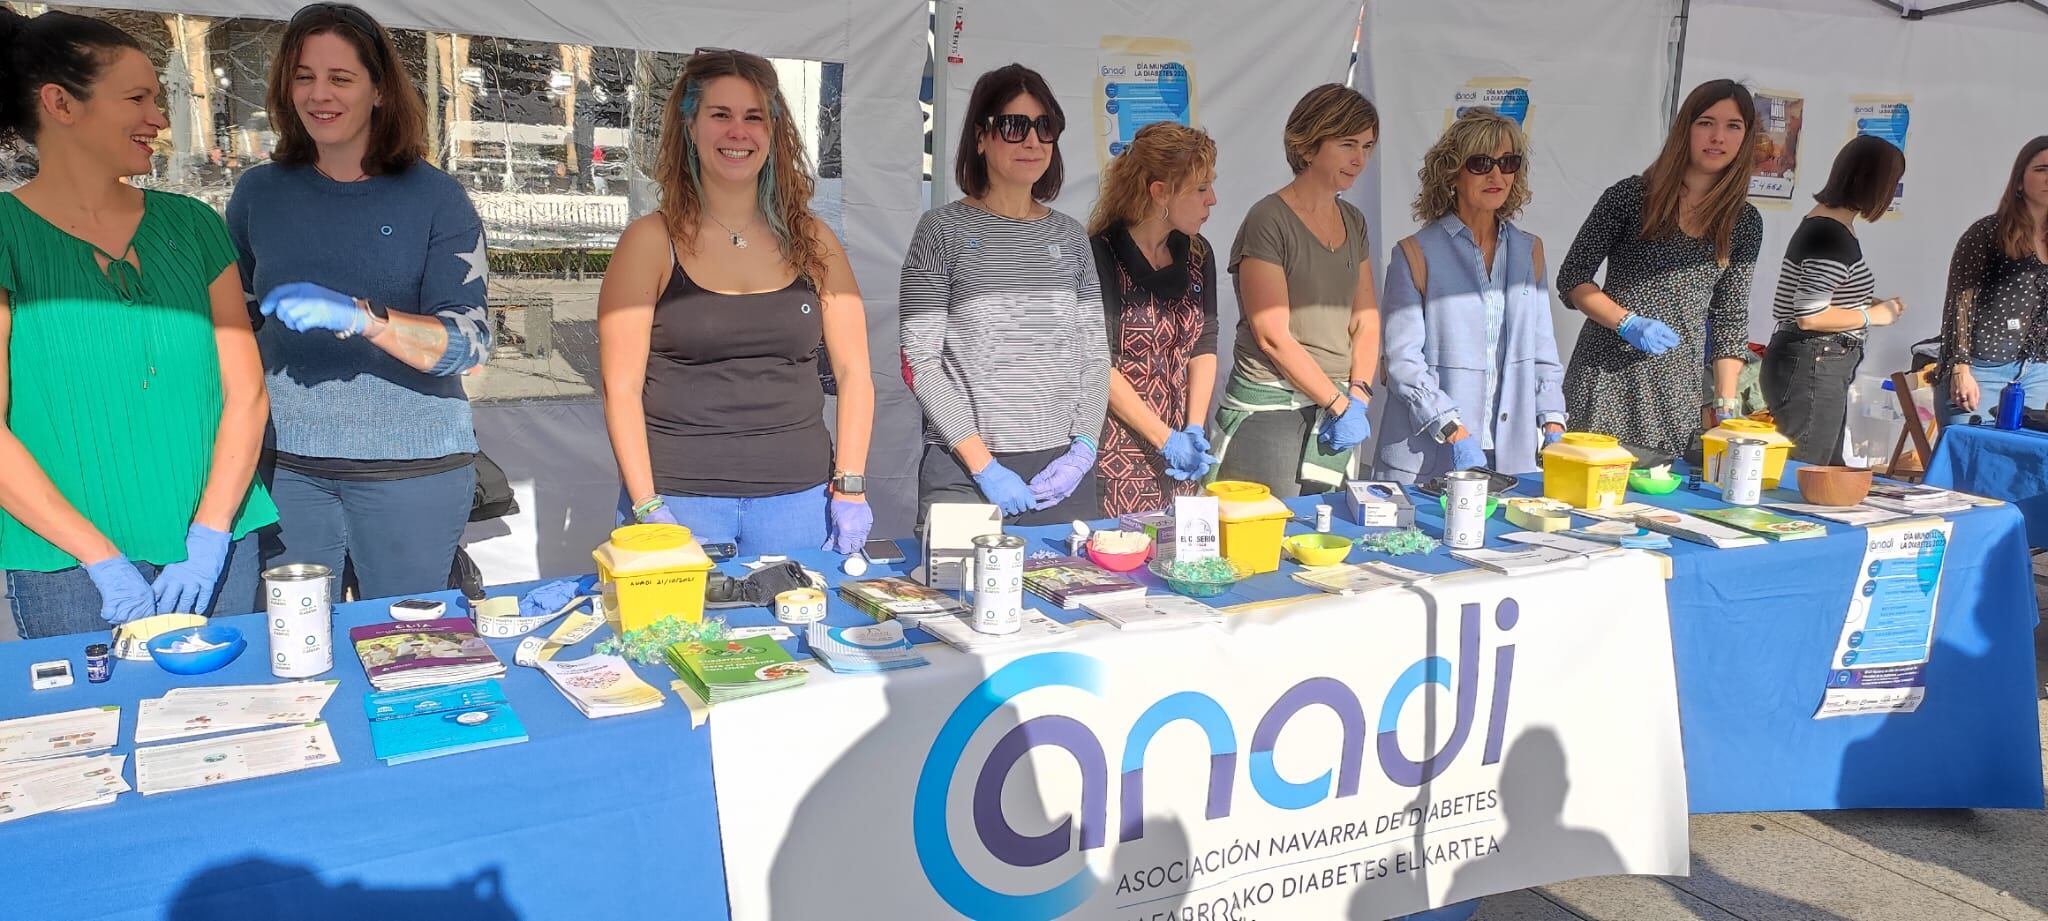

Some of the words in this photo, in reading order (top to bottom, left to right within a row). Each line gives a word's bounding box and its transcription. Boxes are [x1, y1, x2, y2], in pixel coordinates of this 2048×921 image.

[1116, 839, 1260, 896] ASOCIACIÓN
[1269, 821, 1368, 857] NAVARRA
[1375, 812, 1403, 835] DE
[1409, 789, 1497, 827] DIABETES
[1282, 858, 1388, 898] DIABETES
[1395, 835, 1500, 874] ELKARTEA
